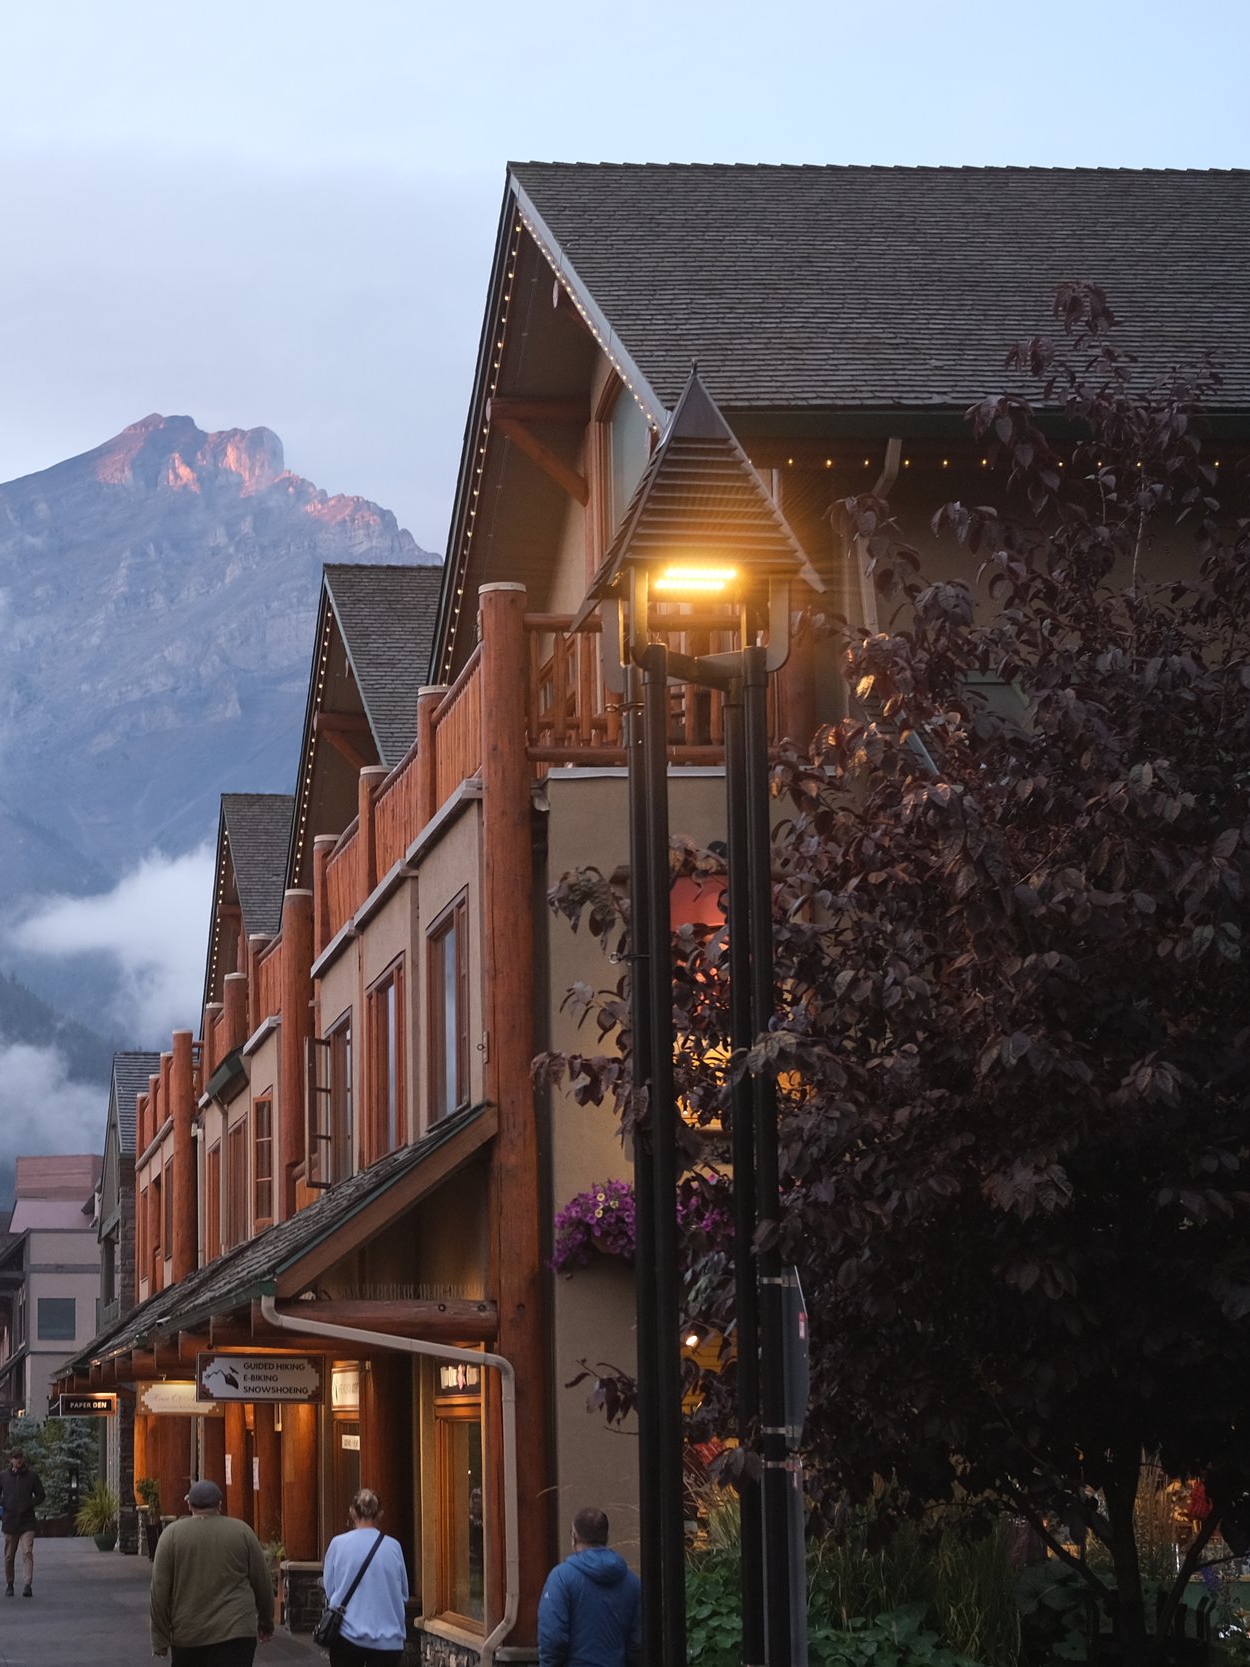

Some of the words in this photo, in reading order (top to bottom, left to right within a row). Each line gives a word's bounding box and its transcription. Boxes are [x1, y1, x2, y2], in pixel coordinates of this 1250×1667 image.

[243, 1362, 275, 1370] GUIDED
[276, 1362, 306, 1370] HIKING
[243, 1374, 279, 1382] E-BIKING
[243, 1386, 309, 1394] SNOWSHOEING
[70, 1401, 92, 1409] PAPER
[92, 1401, 108, 1409] DEN
